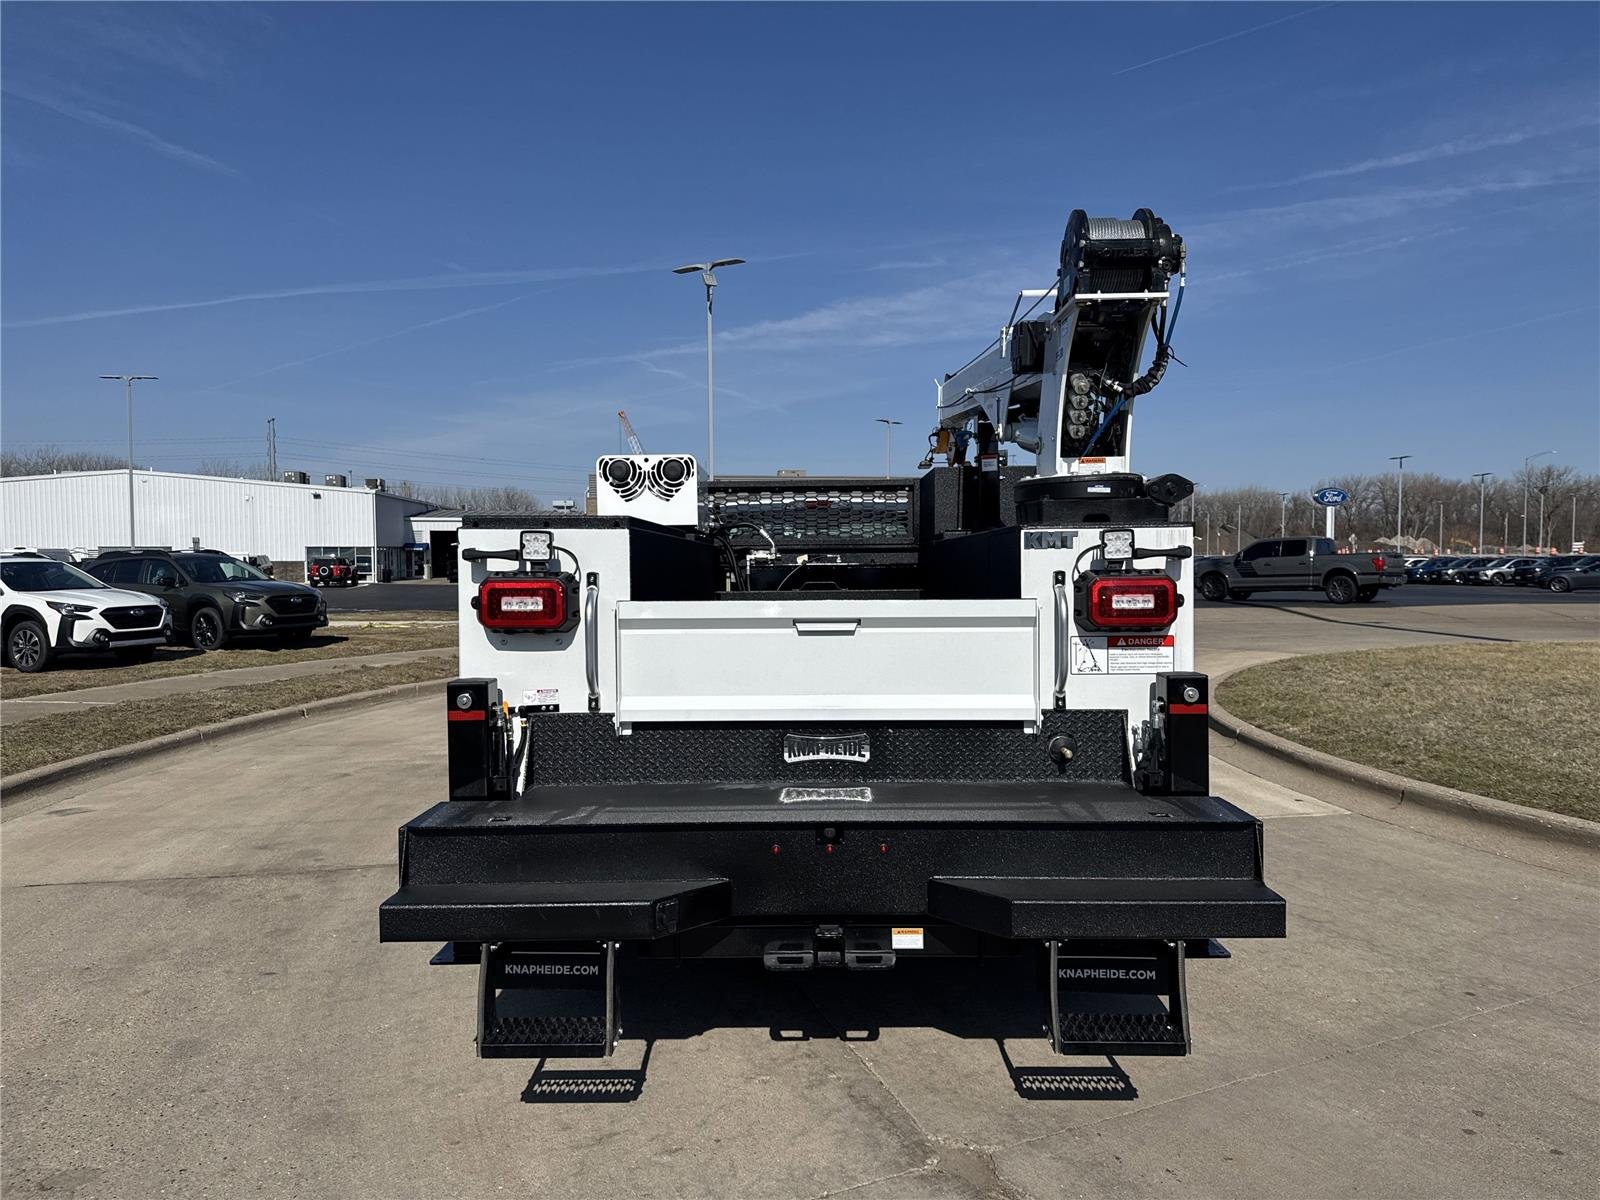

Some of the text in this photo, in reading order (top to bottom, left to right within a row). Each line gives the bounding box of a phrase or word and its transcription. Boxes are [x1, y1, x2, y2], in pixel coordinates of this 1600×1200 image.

[1323, 491, 1343, 502] Ford
[1128, 637, 1165, 645] DANGER
[787, 739, 867, 759] KNAPHEIDE
[504, 964, 599, 975] KNAPHEIDE.COM
[1058, 968, 1156, 980] KNAPHEIDE.COM
